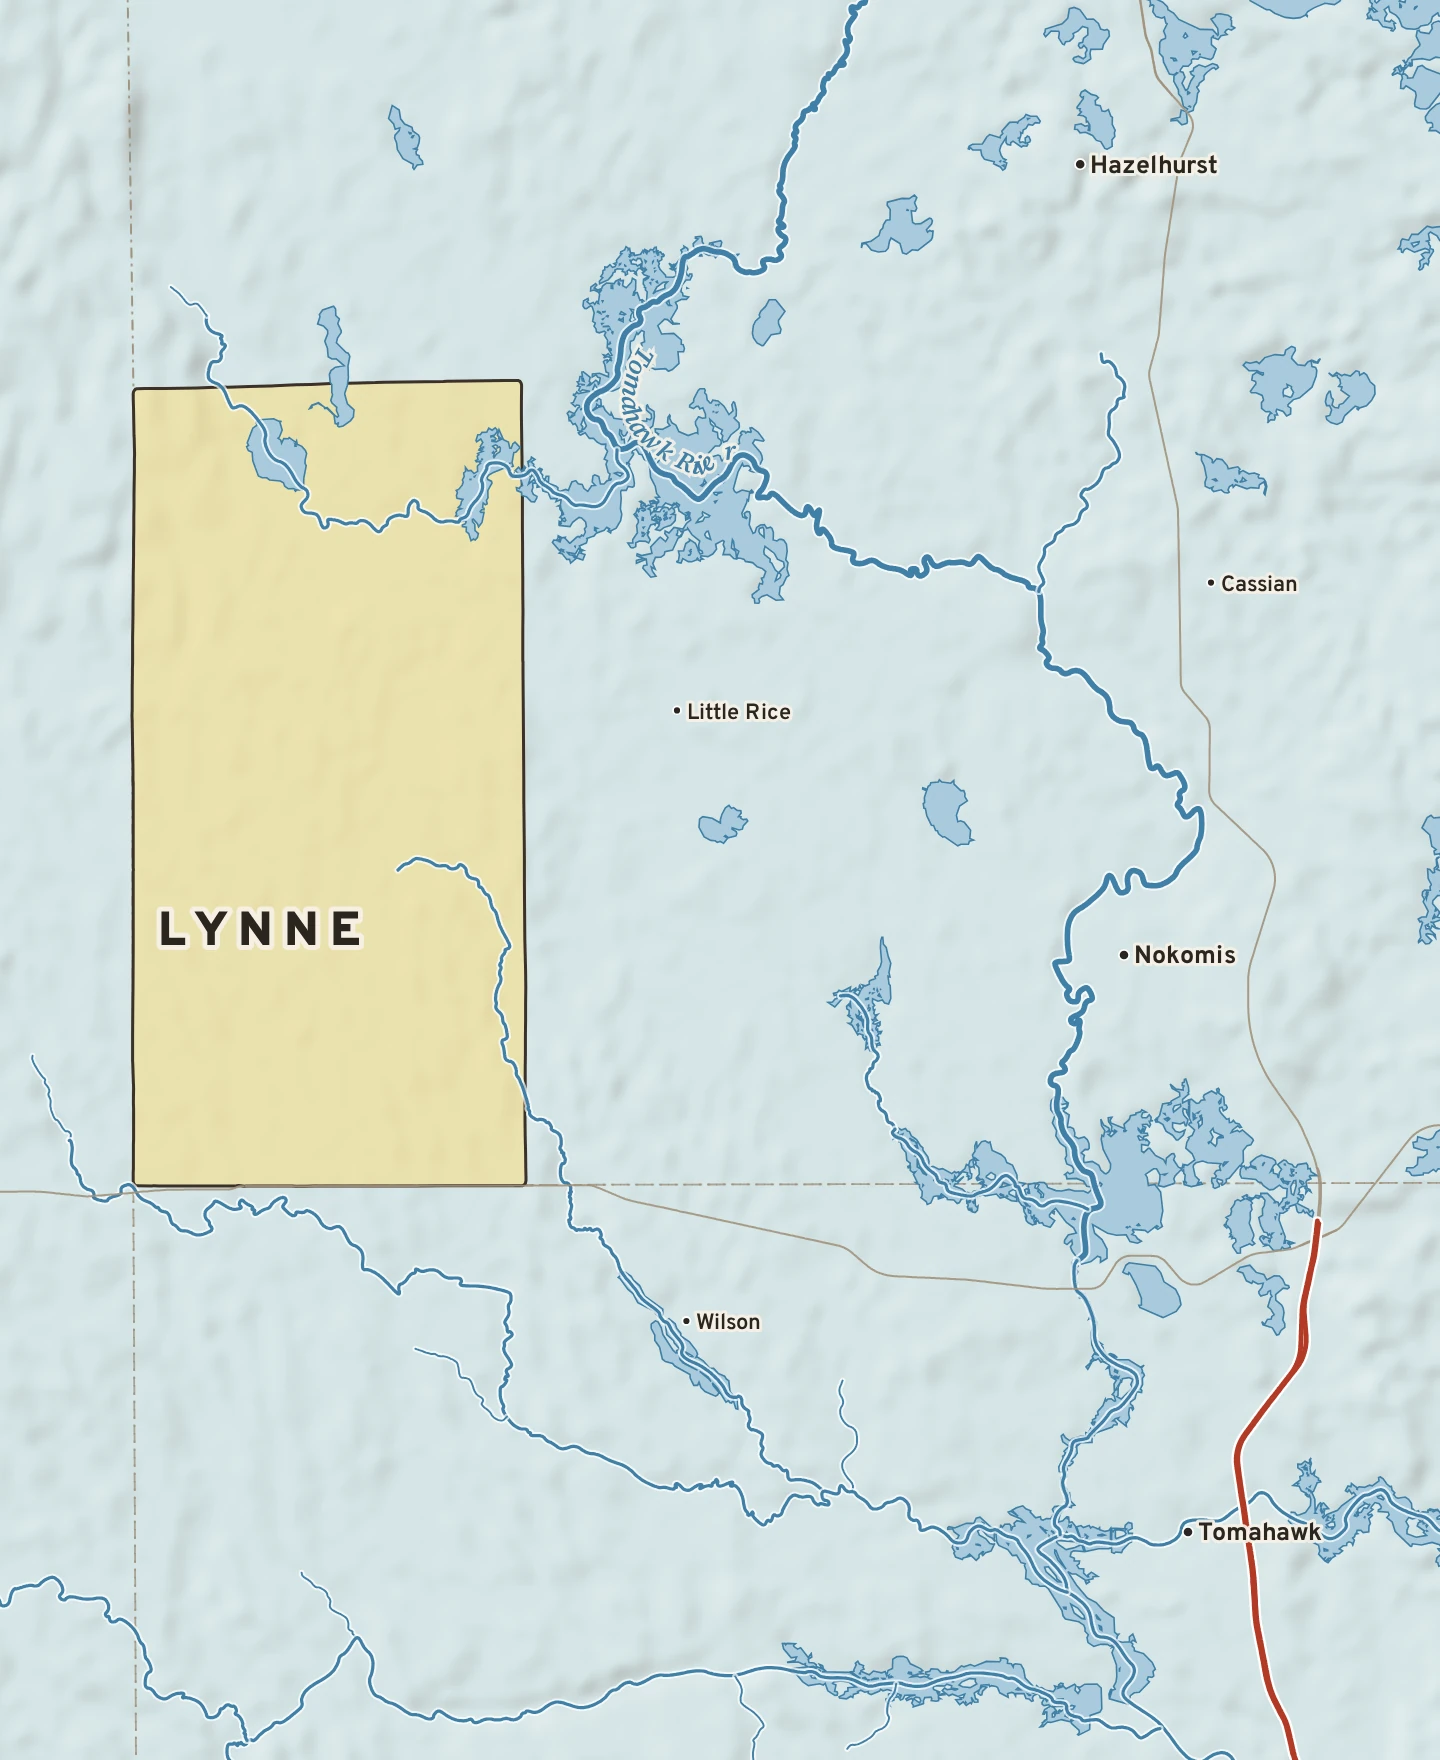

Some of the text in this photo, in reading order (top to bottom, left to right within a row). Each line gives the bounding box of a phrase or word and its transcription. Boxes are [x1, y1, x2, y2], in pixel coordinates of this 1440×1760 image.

[1091, 154, 1217, 174] Hazelhurst
[621, 347, 674, 460] Tomahawk
[1221, 574, 1297, 592] Cassian
[688, 702, 791, 720] Little Rice
[160, 911, 361, 946] LYNNE
[1135, 944, 1236, 964] Nokomis
[696, 1313, 760, 1330] Wilson
[1198, 1521, 1322, 1541] Tomahawk
